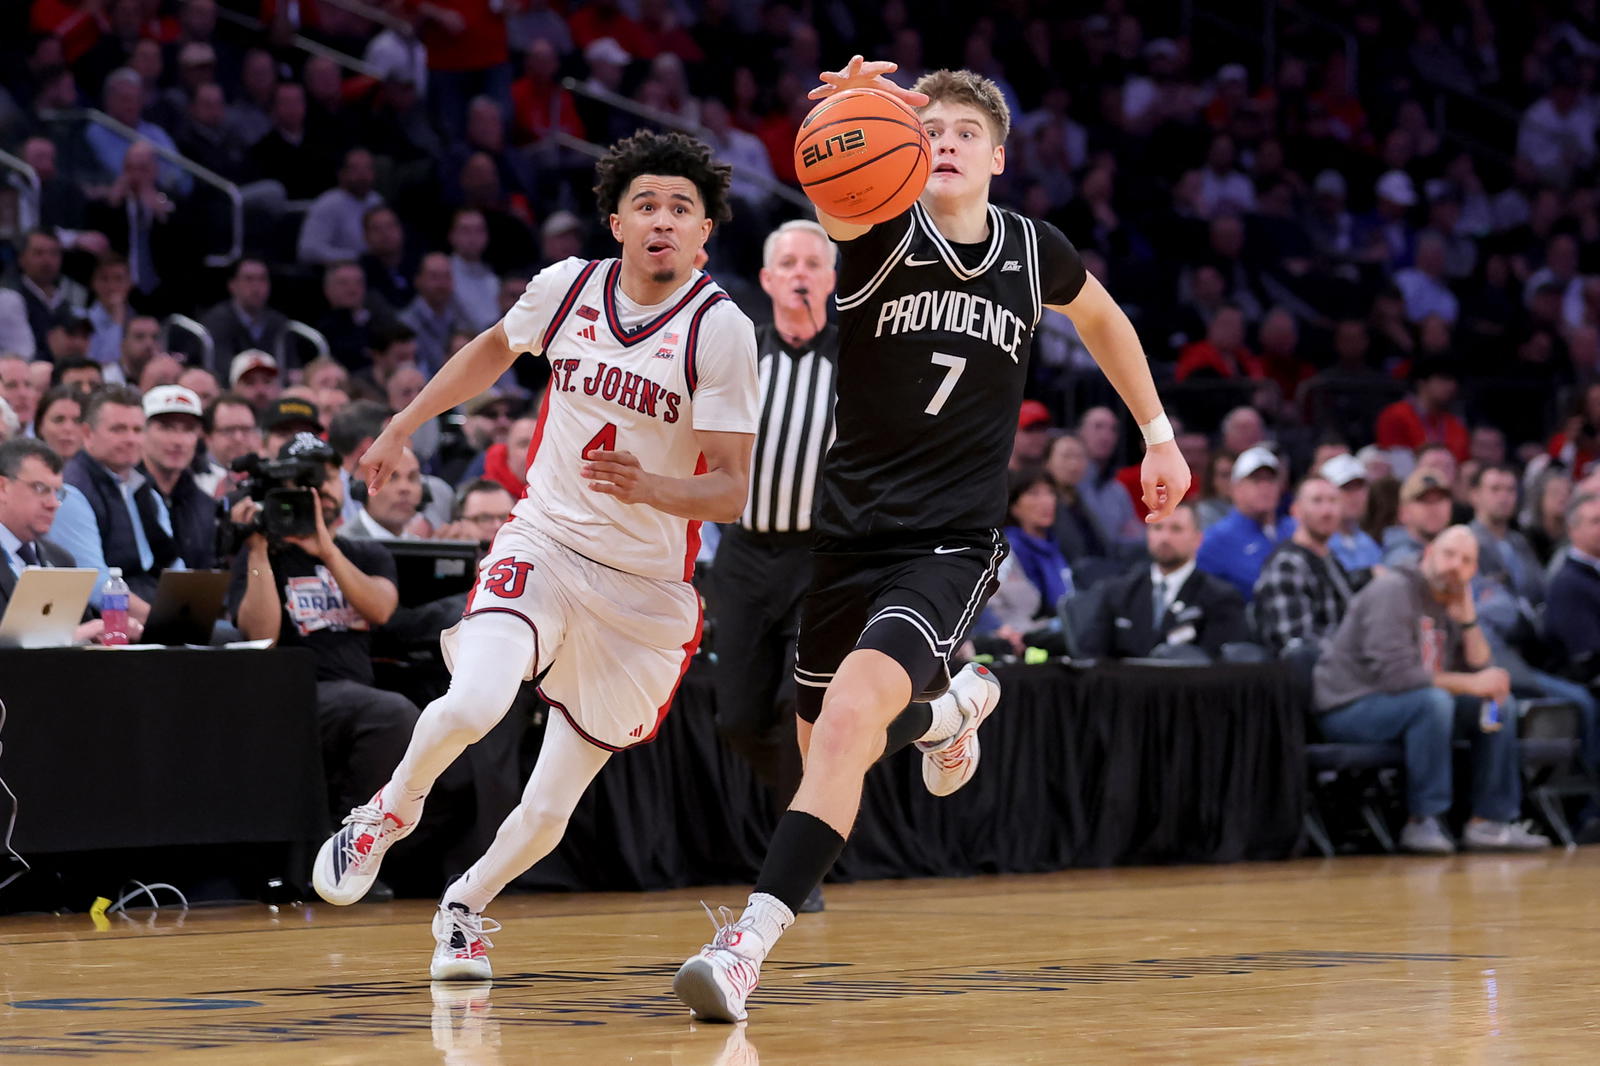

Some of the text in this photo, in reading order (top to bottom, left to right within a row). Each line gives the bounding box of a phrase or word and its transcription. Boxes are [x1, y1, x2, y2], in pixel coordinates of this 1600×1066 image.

[874, 290, 1026, 364] PROVIDENCE
[552, 358, 681, 424] ST. JOHN'S
[924, 351, 967, 416] 7
[581, 422, 617, 461] 4
[298, 595, 348, 615] DRA
